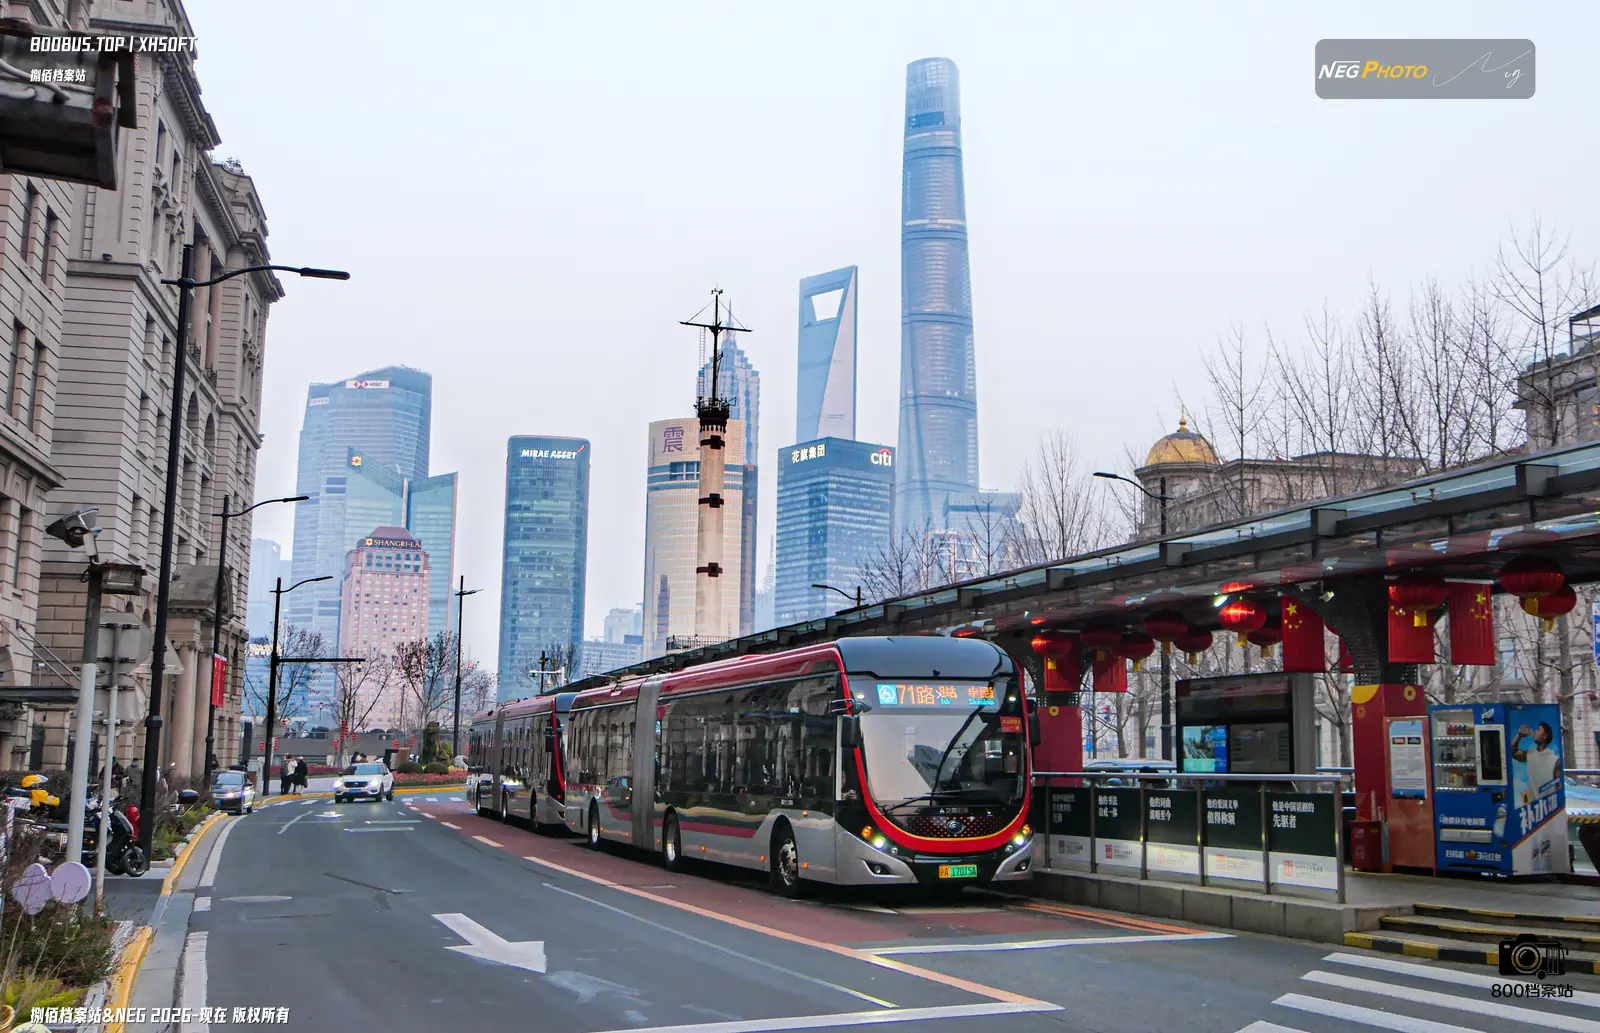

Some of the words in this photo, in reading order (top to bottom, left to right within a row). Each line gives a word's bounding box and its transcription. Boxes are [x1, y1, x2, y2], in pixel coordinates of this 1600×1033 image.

[521, 449, 549, 458] MIRAE
[550, 450, 577, 460] ASSET
[791, 443, 826, 464] 花旗集团
[870, 448, 892, 467] citi
[373, 539, 421, 548] SHANGRI-LA
[896, 684, 936, 705] 71路
[1272, 800, 1315, 813] 他是中国话剧的
[1207, 811, 1236, 825] 值得称颂
[1273, 814, 1297, 829] 先驱者
